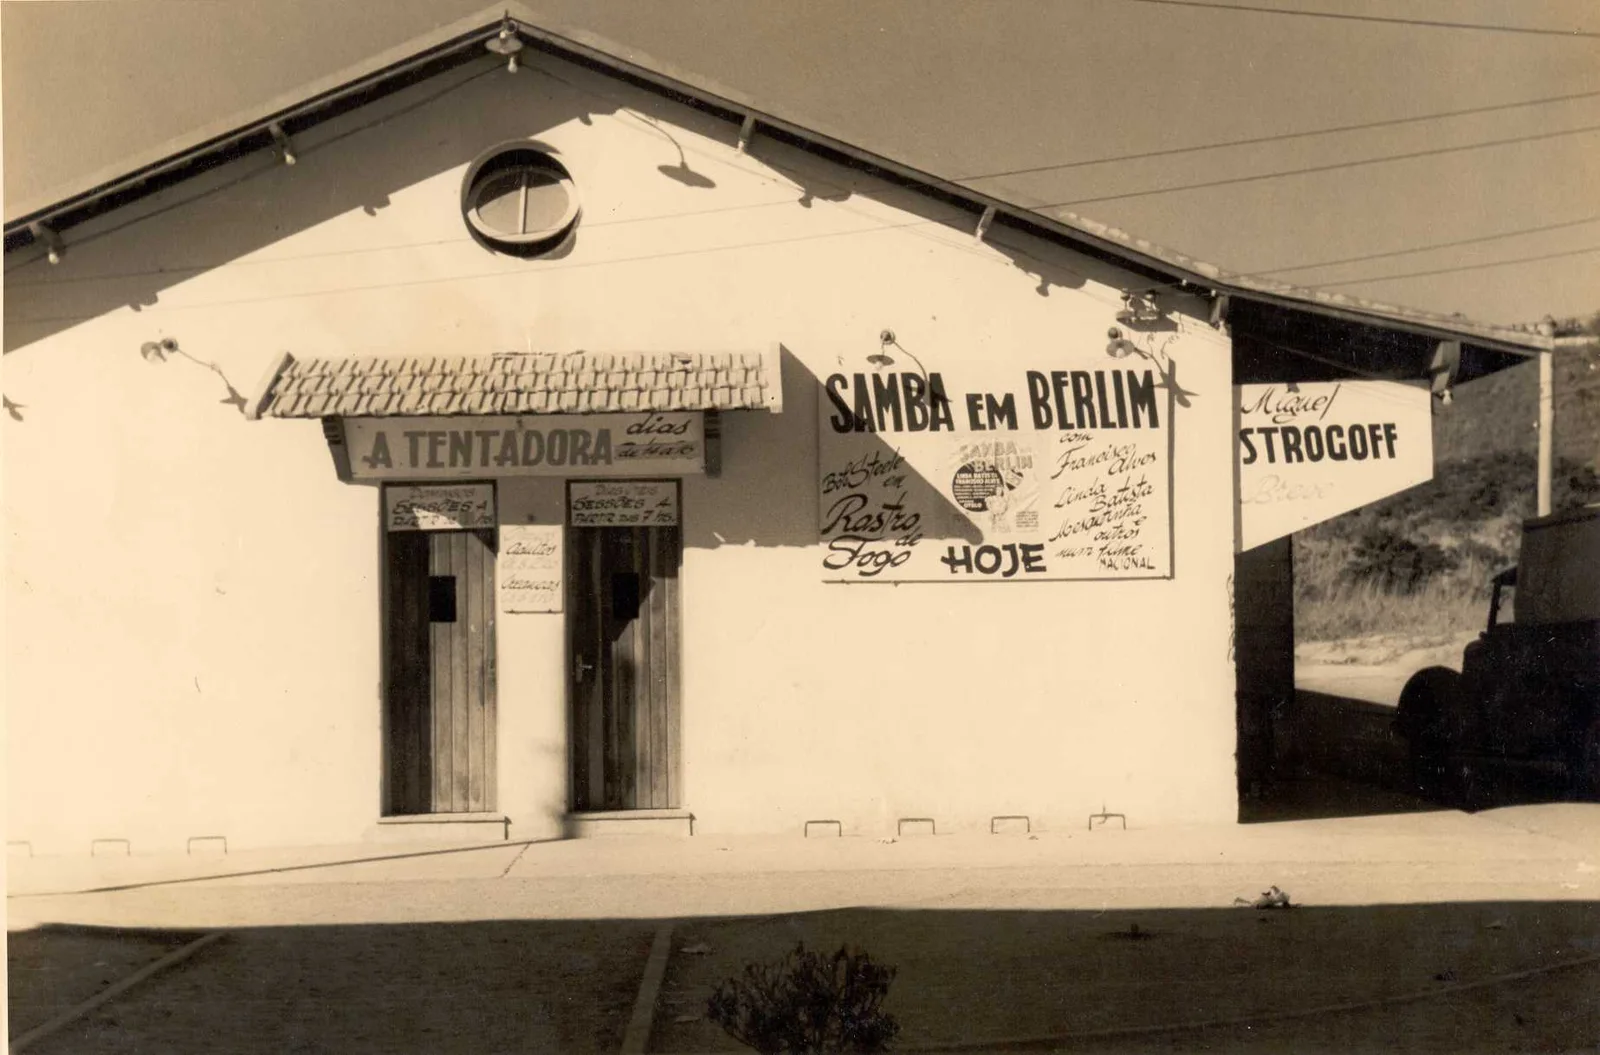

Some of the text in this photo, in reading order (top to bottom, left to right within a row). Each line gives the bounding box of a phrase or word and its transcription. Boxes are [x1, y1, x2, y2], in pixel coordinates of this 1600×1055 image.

[826, 370, 1159, 433] SAMBA EM BERLIM
[1240, 383, 1341, 424] Miguel
[626, 411, 692, 435] dias
[362, 429, 613, 469] A TENTADORA
[1239, 423, 1397, 465] STROGOFF
[820, 491, 920, 535] Rastro
[823, 534, 911, 577] Fogo
[895, 526, 923, 547] de
[941, 543, 1047, 577] HOJE
[1100, 557, 1155, 570] NACIONAL
